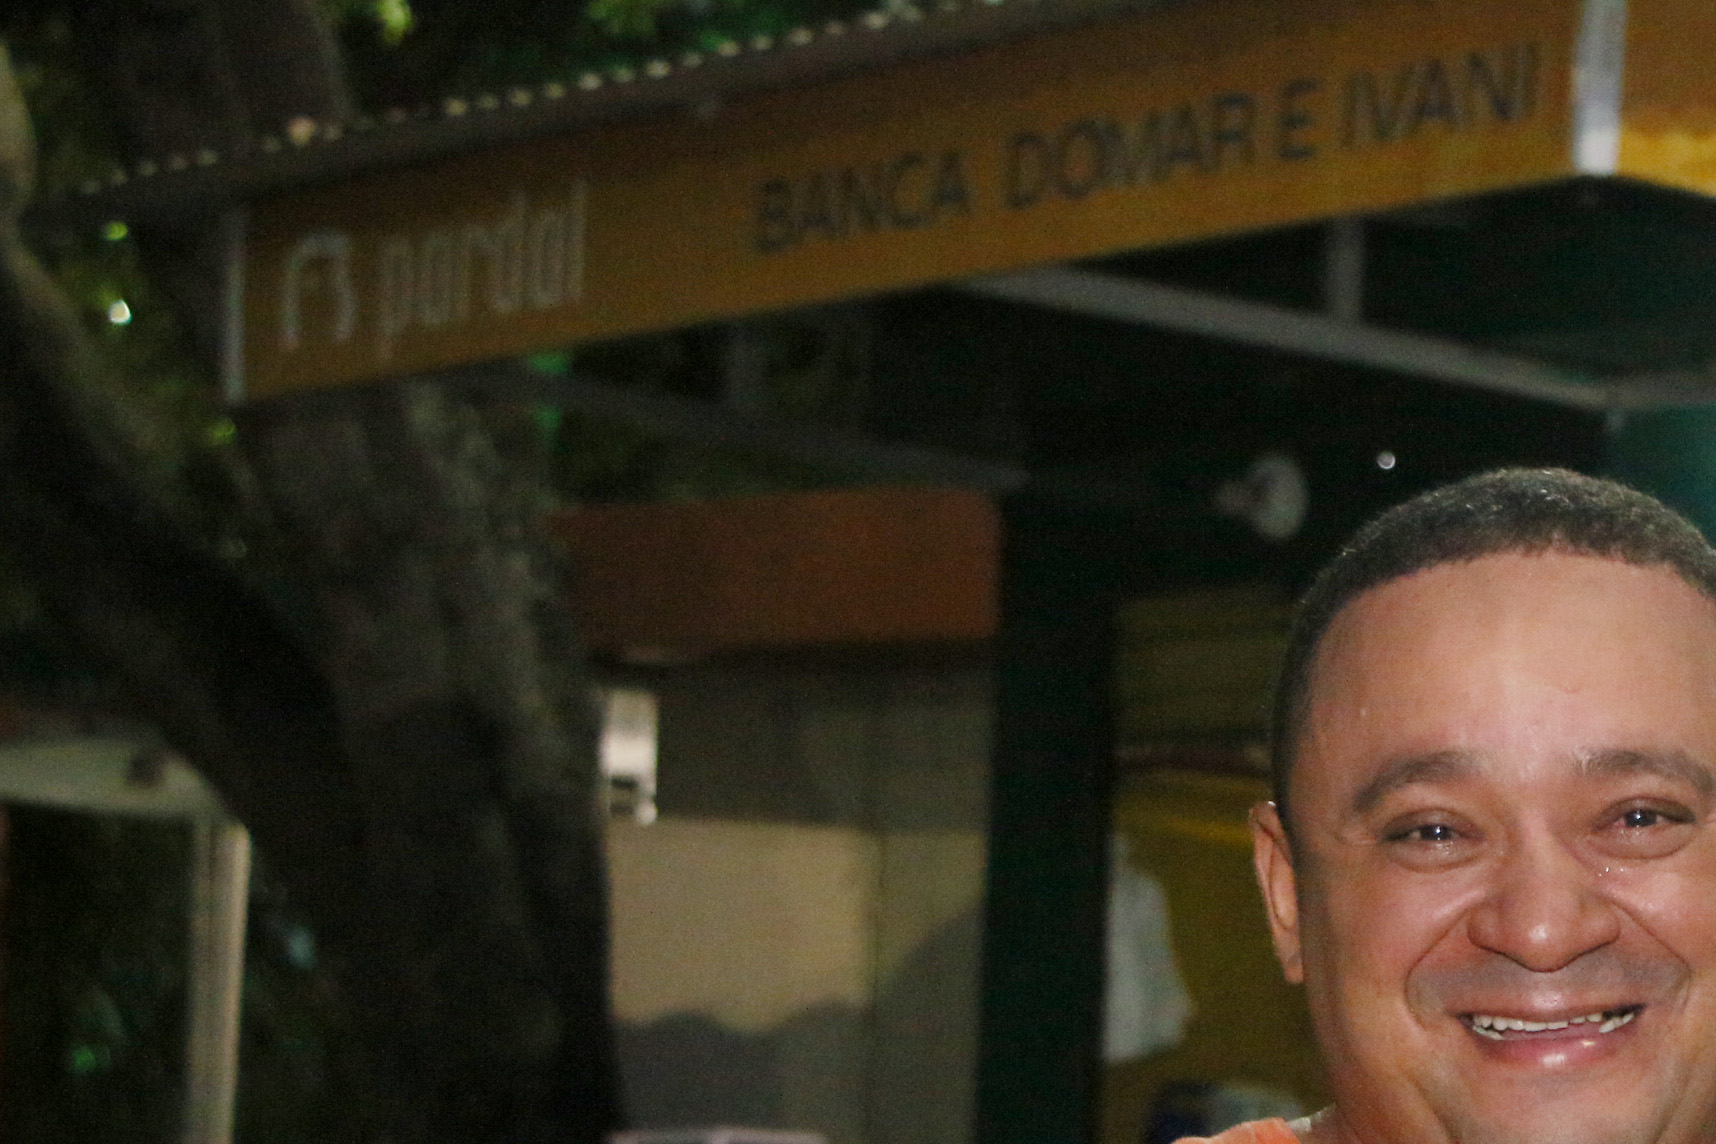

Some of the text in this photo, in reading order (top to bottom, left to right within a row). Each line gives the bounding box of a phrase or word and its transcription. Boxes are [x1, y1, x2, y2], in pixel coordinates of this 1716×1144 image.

[756, 45, 1540, 253] BANCA DOMAR E IVANI
[380, 181, 584, 360] pardal
